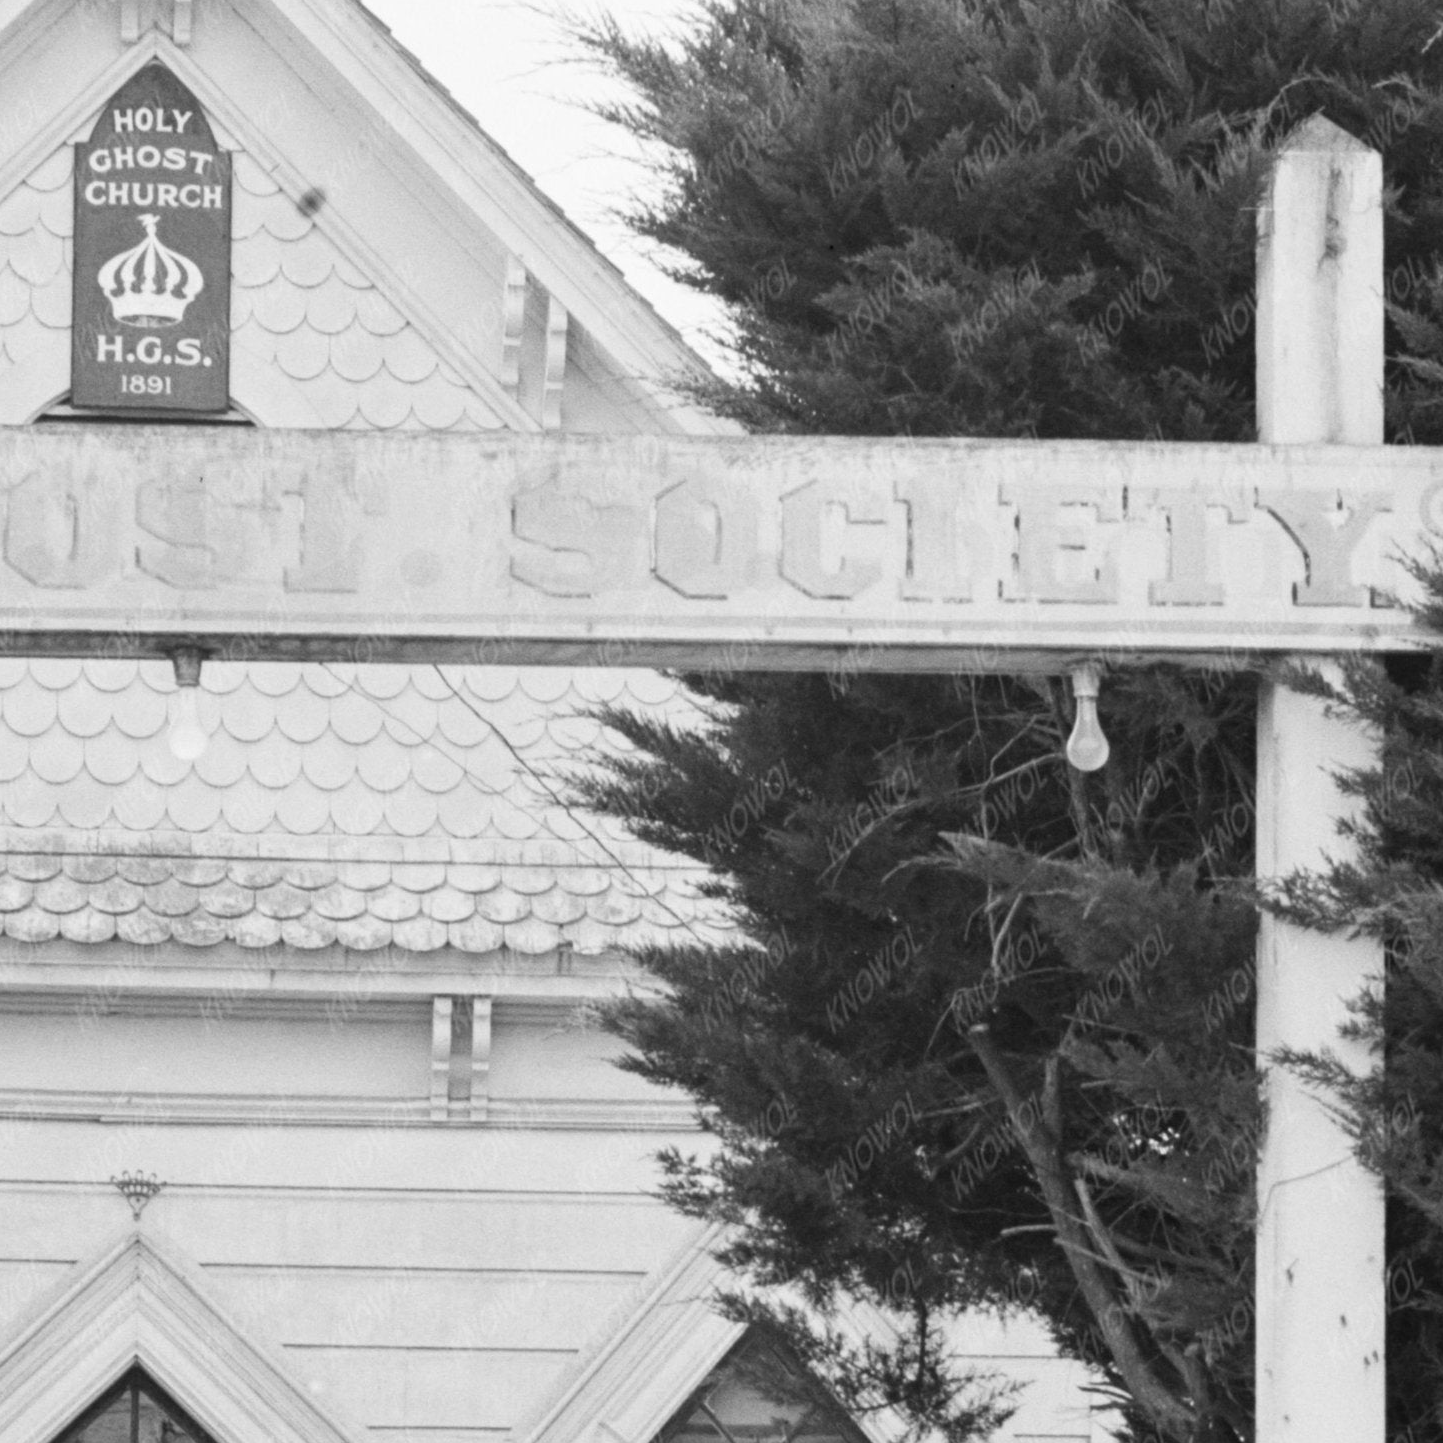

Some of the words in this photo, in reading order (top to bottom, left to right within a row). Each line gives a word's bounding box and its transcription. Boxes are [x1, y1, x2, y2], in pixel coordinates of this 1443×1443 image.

[113, 107, 192, 134] HOLY
[89, 146, 213, 175] GHOST
[85, 181, 223, 209] CHURCH
[96, 335, 213, 368] H.G.S.
[121, 374, 172, 395] 1891
[507, 464, 1393, 610] SOCIETY
